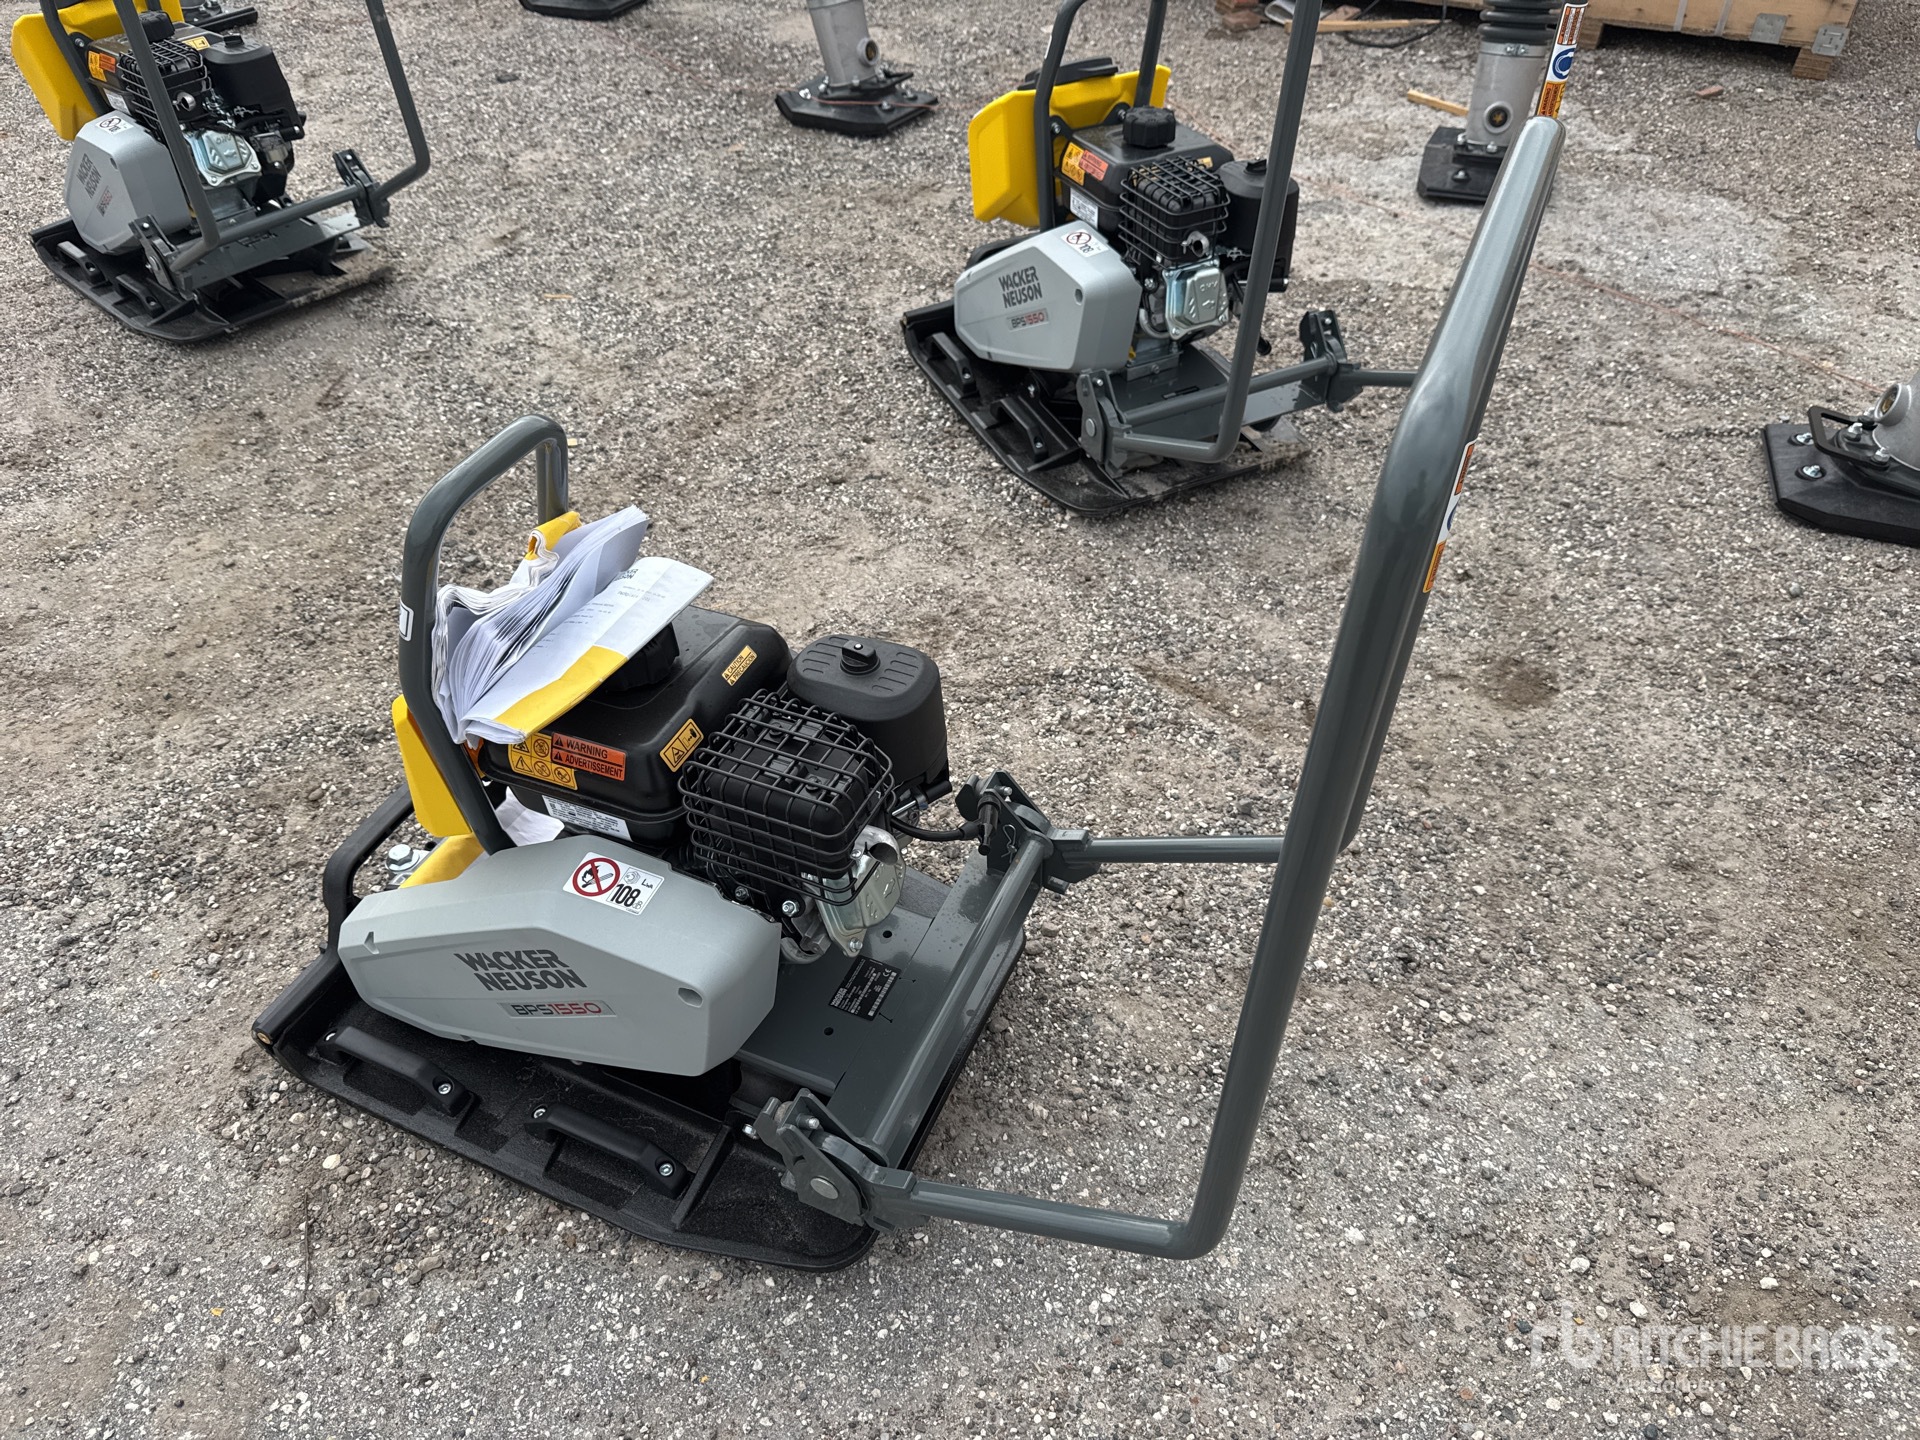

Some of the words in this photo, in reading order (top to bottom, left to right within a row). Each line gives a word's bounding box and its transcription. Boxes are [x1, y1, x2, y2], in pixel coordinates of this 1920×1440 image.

[998, 266, 1039, 292] WACKER
[1002, 282, 1043, 309] NEUSON
[1011, 312, 1045, 329] BPS1550
[727, 655, 744, 674] CAUTION
[566, 739, 608, 759] WARNING
[564, 754, 623, 779] ADVERTISSEMENT
[610, 883, 641, 908] 108
[453, 949, 570, 972] WACKER
[473, 969, 588, 992] NEUSON
[510, 1002, 602, 1016] BPS1550
